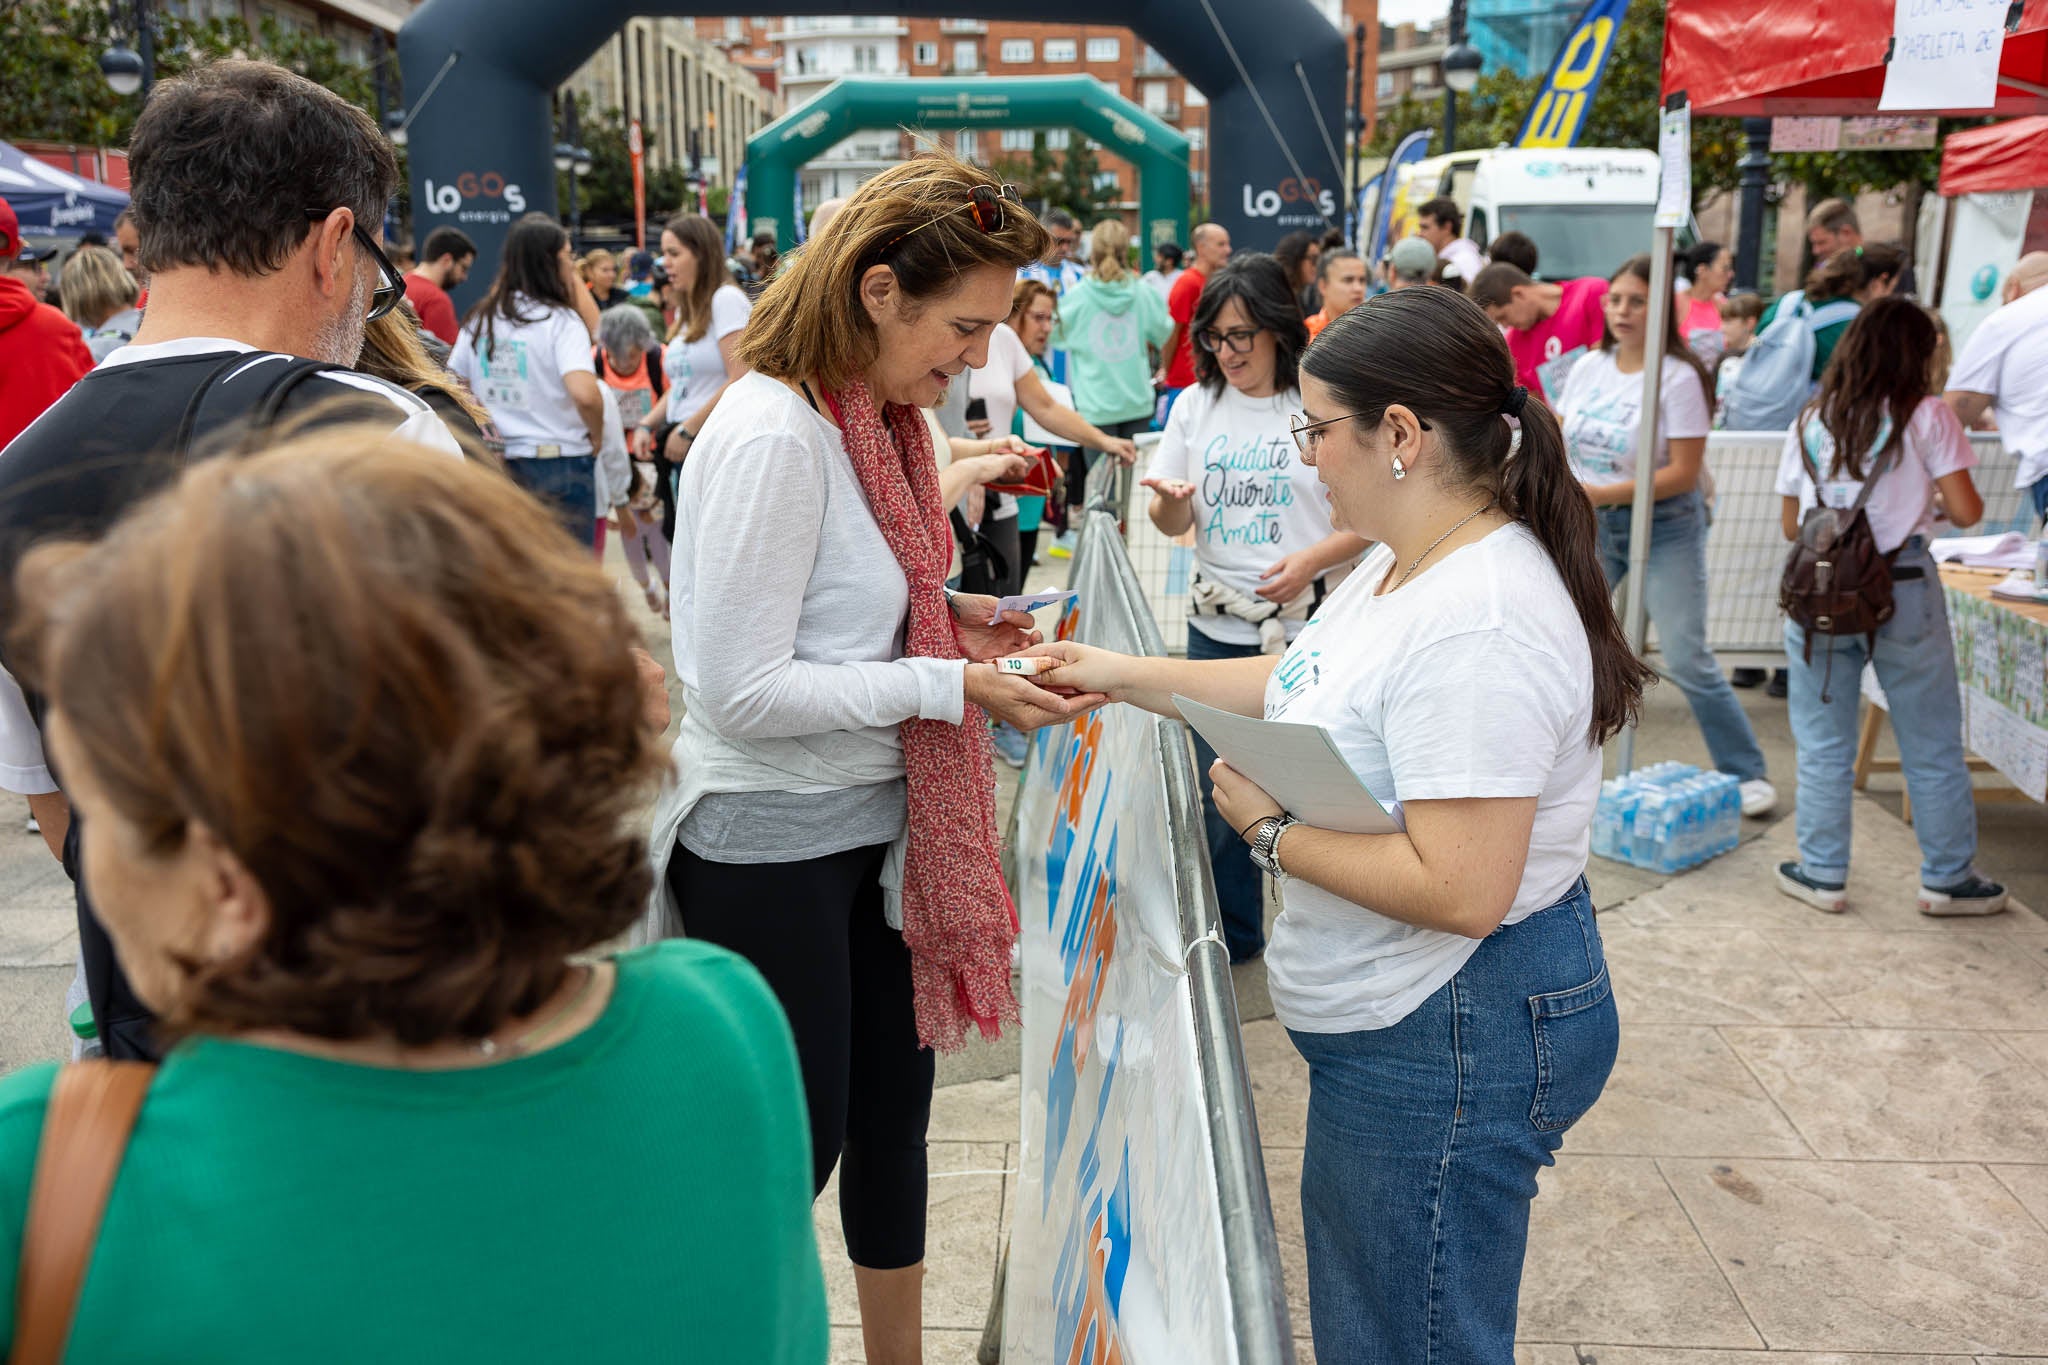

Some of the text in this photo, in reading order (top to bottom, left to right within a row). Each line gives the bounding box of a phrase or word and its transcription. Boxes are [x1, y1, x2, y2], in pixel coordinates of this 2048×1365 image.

[1205, 434, 1290, 472] Cuídate
[1202, 463, 1294, 508] Quiérete
[1007, 659, 1022, 670] 10
